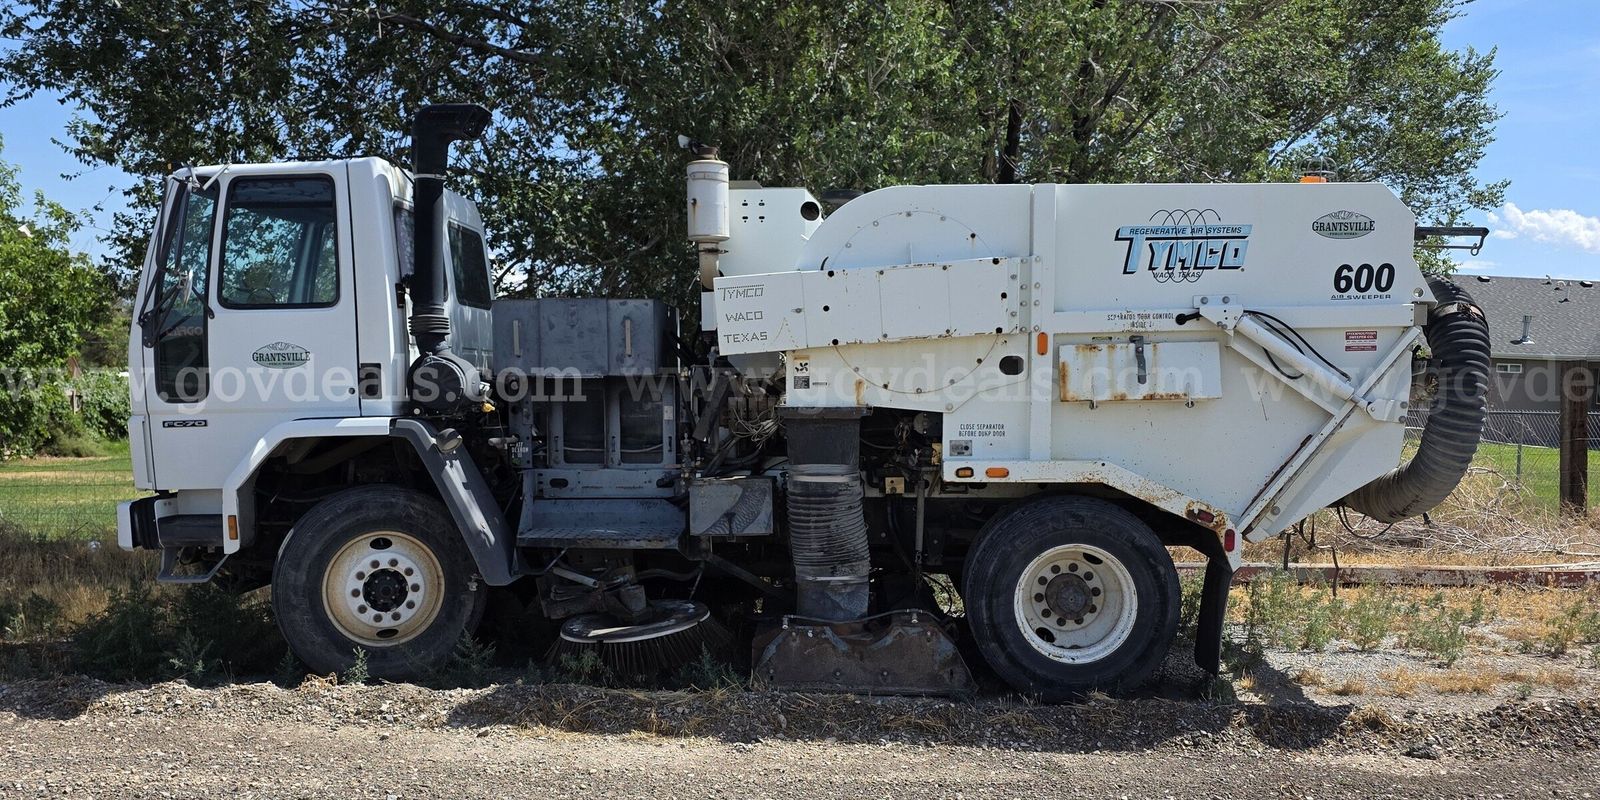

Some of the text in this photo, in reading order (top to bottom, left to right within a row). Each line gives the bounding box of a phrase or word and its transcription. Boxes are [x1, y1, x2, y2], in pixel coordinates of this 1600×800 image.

[1129, 227, 1187, 235] REGENERATIVE
[1207, 226, 1242, 234] SYSTEMS
[1311, 220, 1375, 231] GRANTSVILLE
[1114, 224, 1253, 275] TYMCO
[1333, 262, 1396, 294] 600
[718, 284, 765, 301] TYMCO
[725, 310, 764, 323] WACO
[723, 331, 768, 344] TEXAS
[252, 350, 311, 362] GRANTSVILLE
